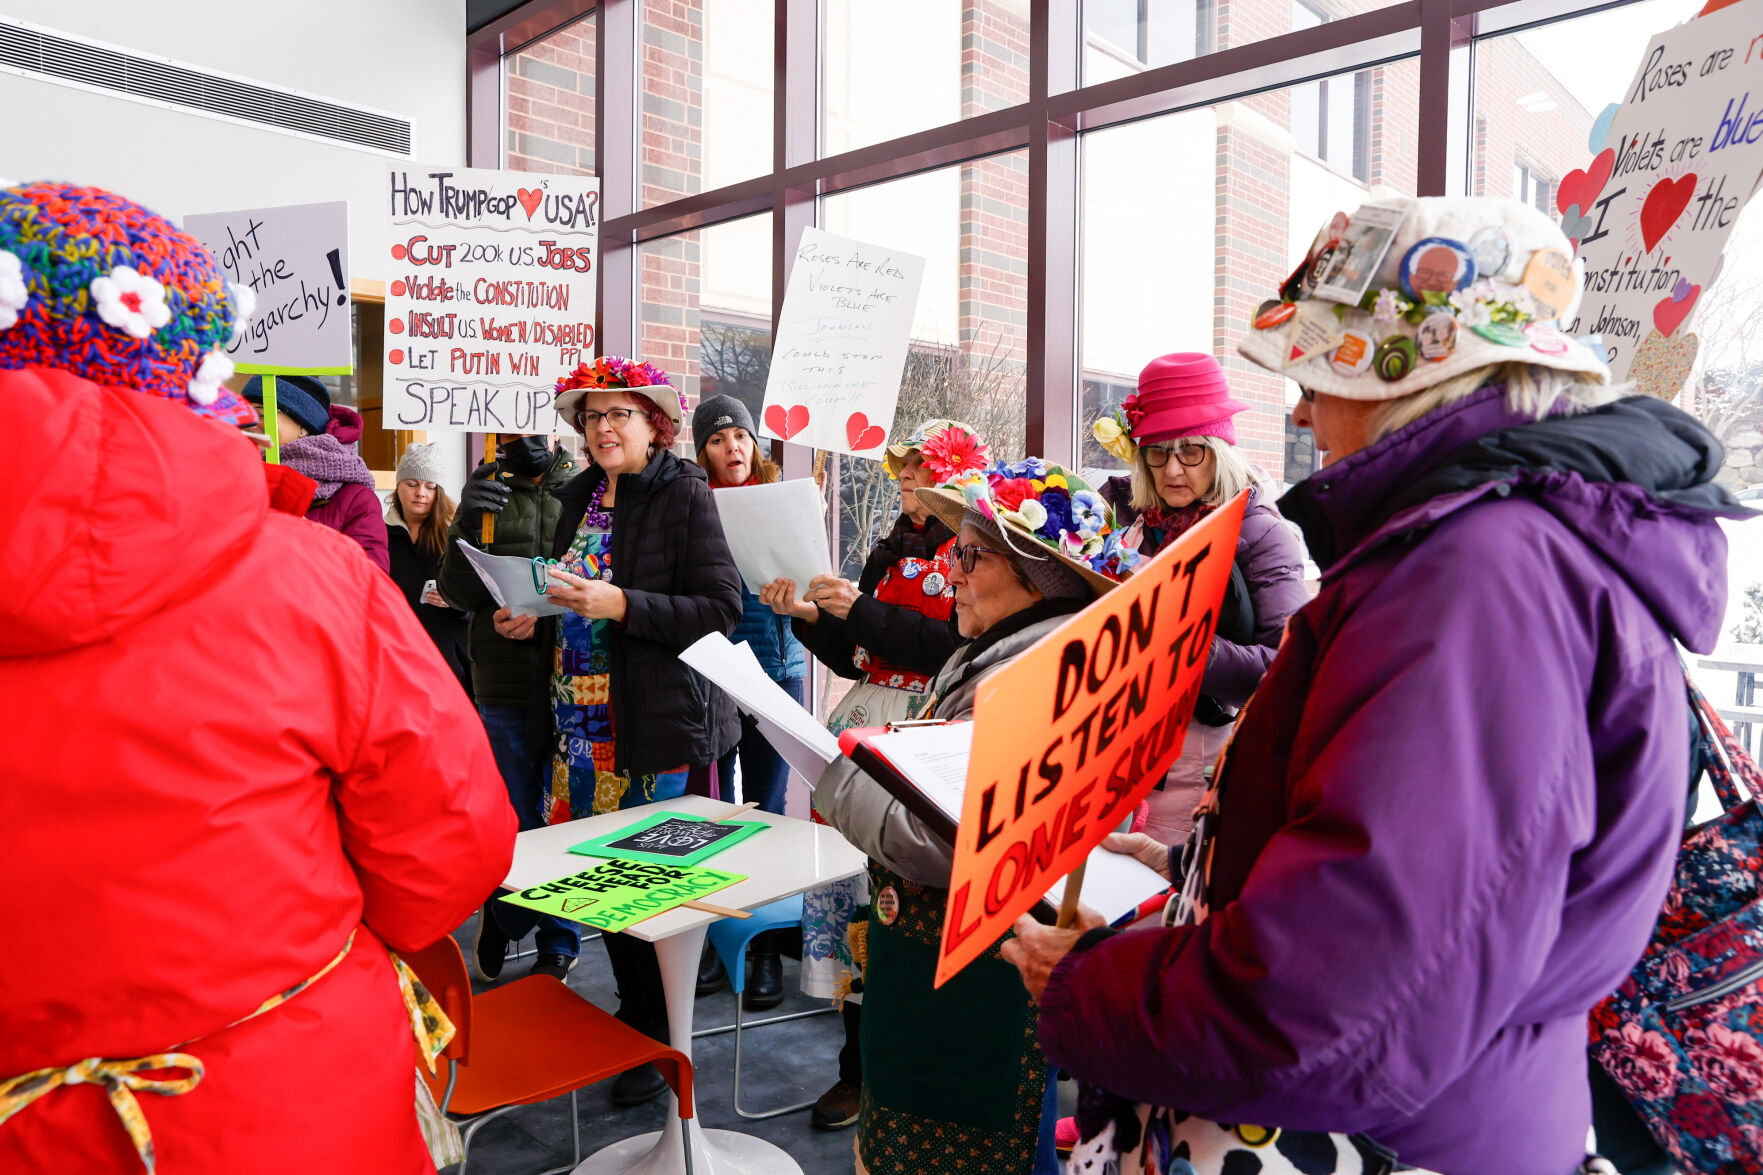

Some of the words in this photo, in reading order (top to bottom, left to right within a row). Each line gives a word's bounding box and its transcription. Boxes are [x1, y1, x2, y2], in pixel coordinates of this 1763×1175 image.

[1630, 45, 1692, 104] Roses
[1699, 48, 1734, 78] are
[1612, 128, 1665, 180] Violets
[1669, 136, 1703, 164] are
[544, 190, 599, 229] USA?
[1580, 187, 1627, 246] I
[1691, 175, 1739, 231] the
[203, 219, 263, 284] ght
[406, 235, 457, 268] CUT
[537, 240, 591, 273] JOBS
[799, 243, 841, 265] ROSES
[846, 251, 872, 271] ARE
[874, 257, 904, 280] RED
[249, 259, 294, 293] the
[455, 281, 472, 302] the
[809, 268, 862, 296] VIOLETS
[867, 288, 898, 304] ARE
[1582, 250, 1680, 294] onstitution
[832, 296, 874, 313] BLUE
[408, 310, 457, 340] INSULT
[1589, 303, 1641, 348] Johnson,
[408, 346, 438, 369] LET
[450, 347, 500, 375] PUTIN
[508, 352, 540, 377] WIN
[802, 366, 846, 375] THIS
[842, 353, 883, 361] STOP
[397, 382, 505, 429] SPEAK
[1051, 541, 1213, 725] DON'T
[975, 660, 1154, 853] LISTEN
[1167, 607, 1213, 690] TO
[520, 859, 636, 901] CHEESE
[628, 869, 694, 890] FOR
[943, 776, 1099, 957] LONE
[578, 871, 732, 928] DEMOCRACY
